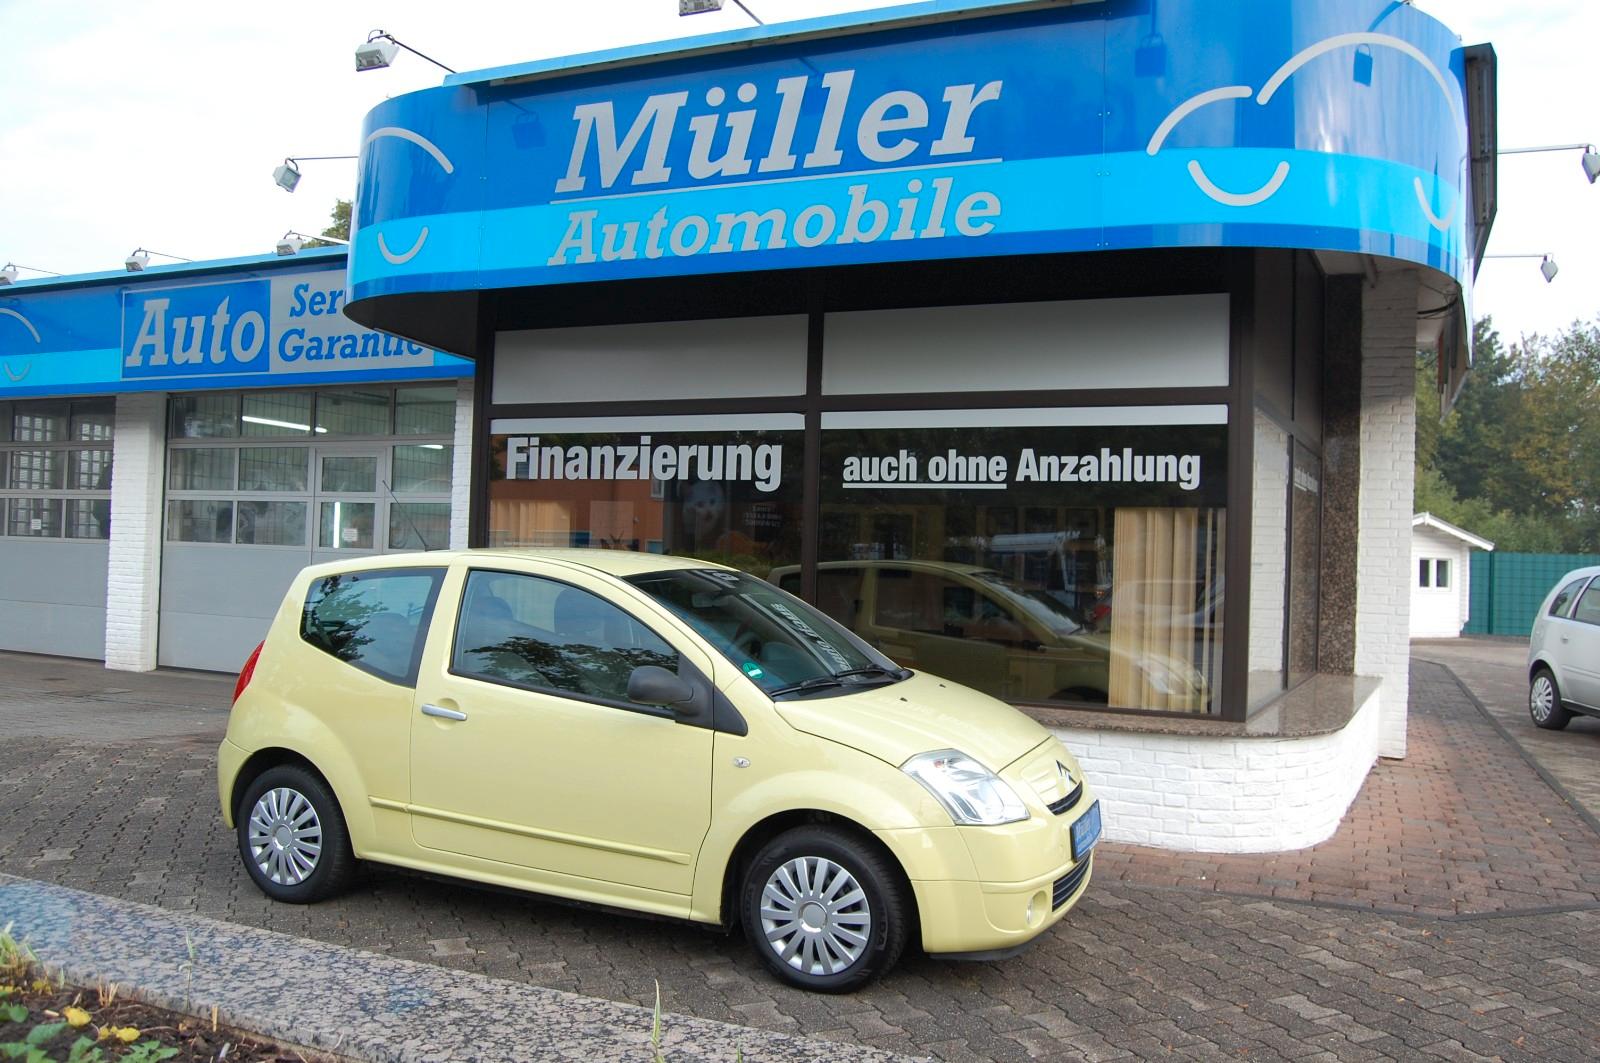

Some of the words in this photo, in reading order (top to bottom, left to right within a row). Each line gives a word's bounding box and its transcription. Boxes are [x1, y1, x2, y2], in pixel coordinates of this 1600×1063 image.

[556, 69, 1002, 193] Müller
[548, 178, 1001, 267] Automobile
[125, 296, 266, 368] Auto
[289, 283, 346, 318] Ser
[506, 435, 782, 492] Finanzierung
[842, 448, 918, 483] auch
[928, 448, 1008, 483] ohne
[1015, 447, 1201, 491] Anzahlung
